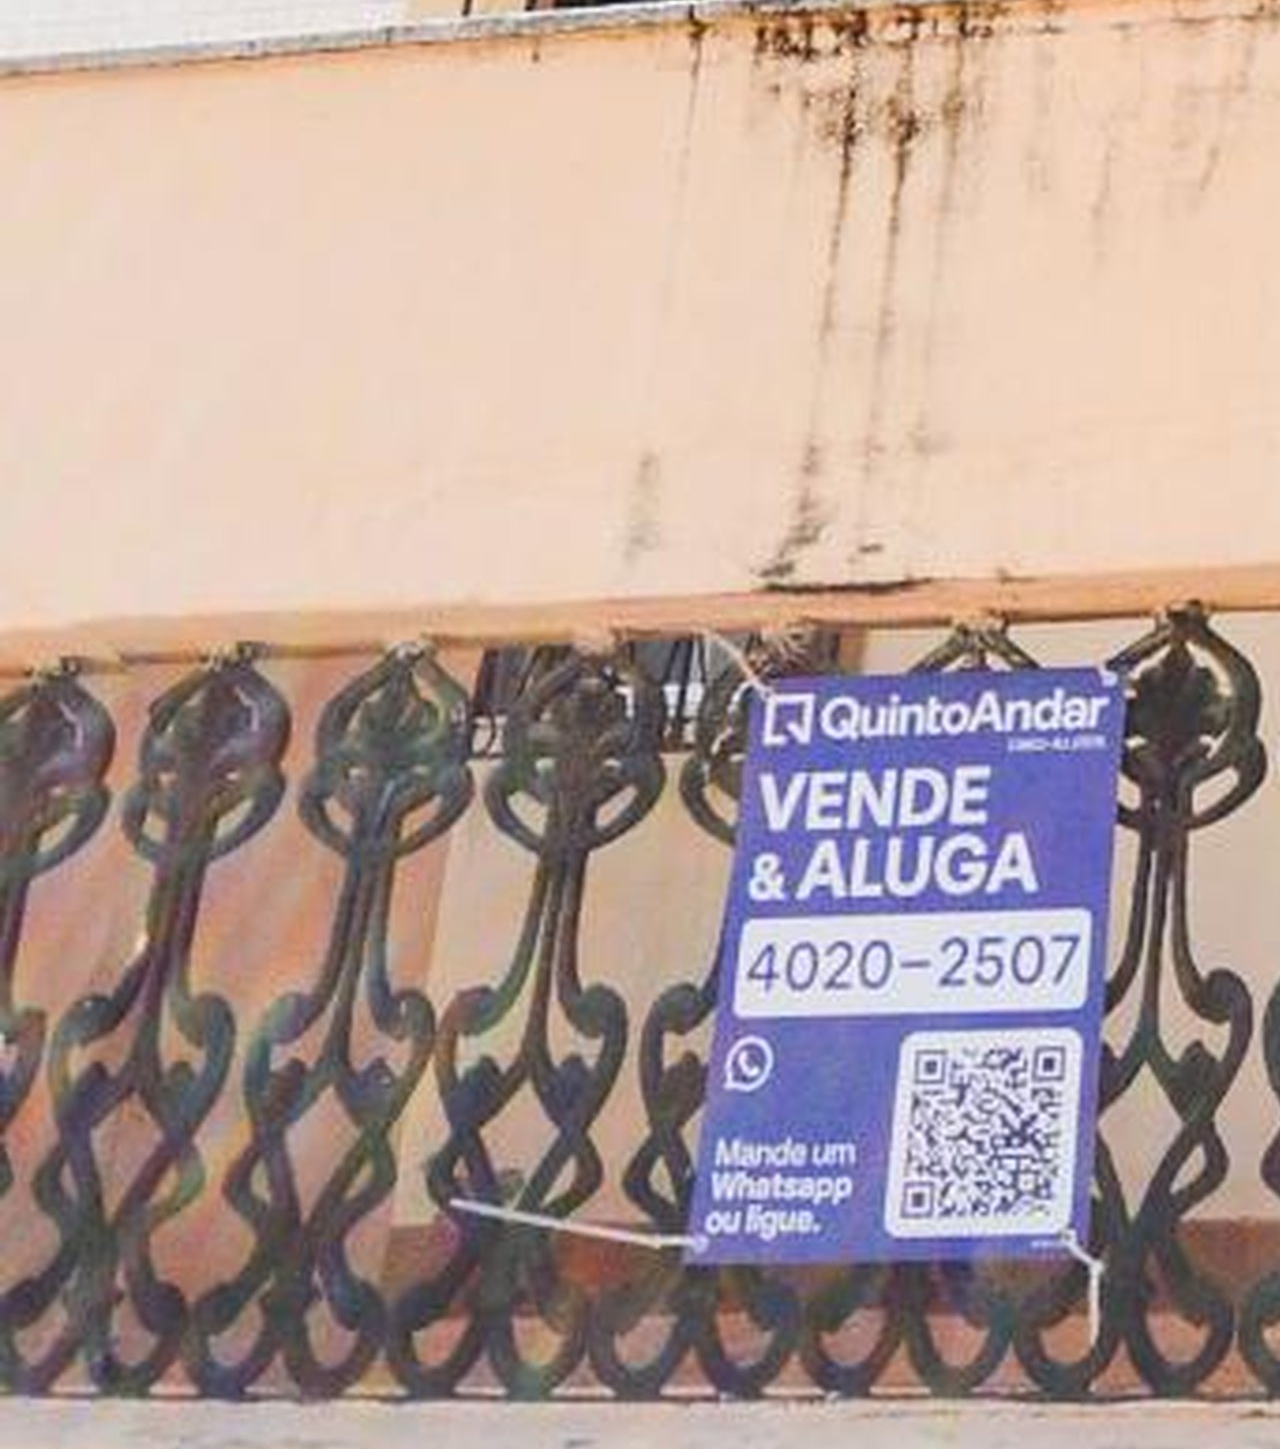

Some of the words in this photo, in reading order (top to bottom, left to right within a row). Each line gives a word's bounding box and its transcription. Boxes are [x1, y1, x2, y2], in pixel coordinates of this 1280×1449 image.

[820, 688, 1110, 740] QuintoAndar
[758, 765, 992, 831] VENDE
[748, 853, 786, 901] &
[795, 832, 1039, 900] ALUGA
[746, 935, 1081, 991] 4020-2507
[715, 1136, 807, 1167] Mande
[811, 1143, 857, 1167] um
[711, 1171, 853, 1205] Whatsapp
[704, 1209, 742, 1235] ou
[745, 1204, 821, 1241] ligue.
